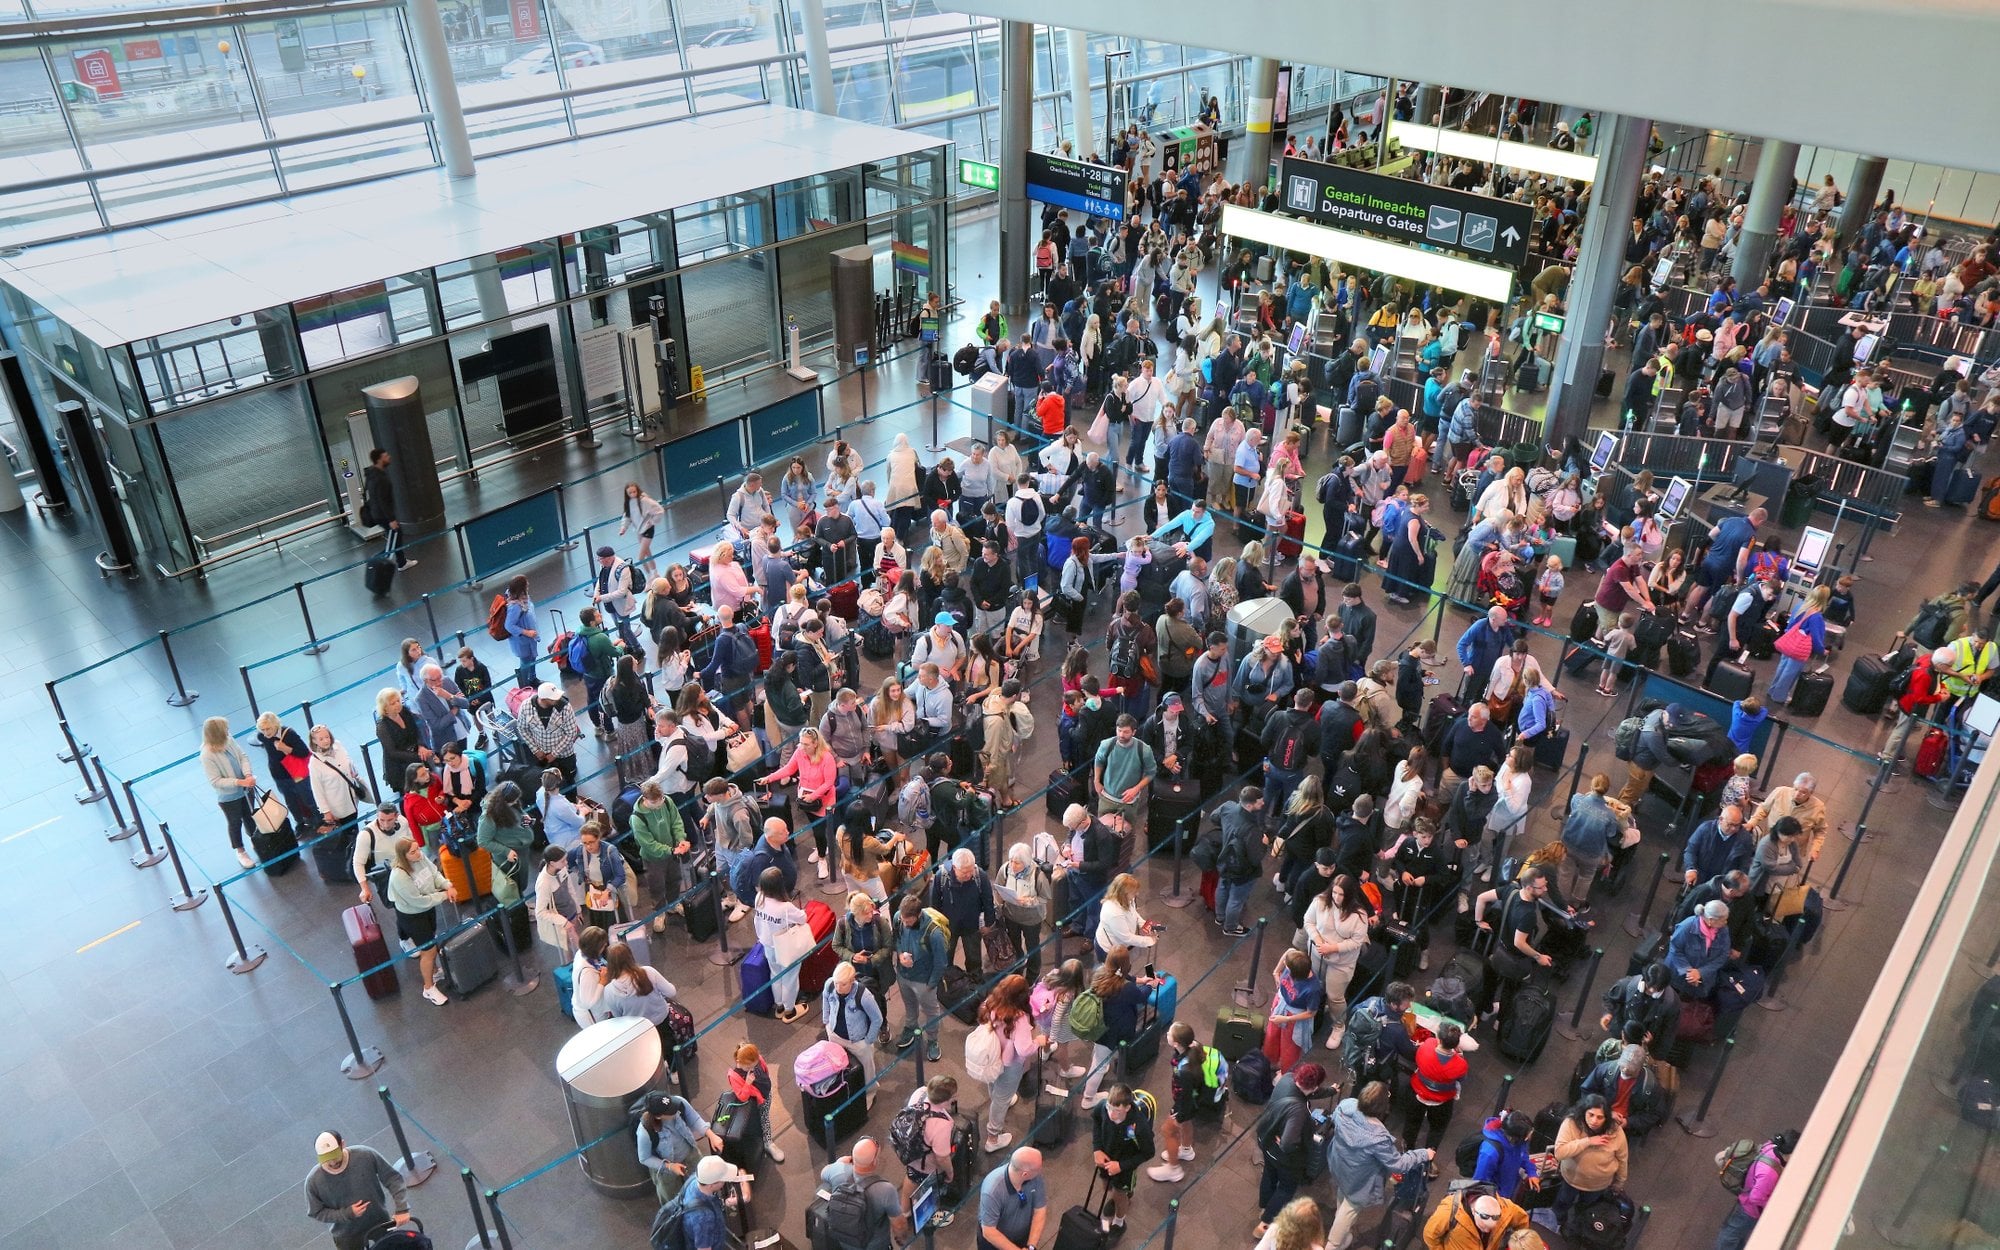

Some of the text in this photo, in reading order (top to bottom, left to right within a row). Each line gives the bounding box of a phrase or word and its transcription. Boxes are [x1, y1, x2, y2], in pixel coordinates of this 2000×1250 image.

[1081, 167, 1101, 181] 1-28
[1322, 199, 1424, 234] Departure Gates
[1325, 186, 1426, 219] Geataí Imeachta
